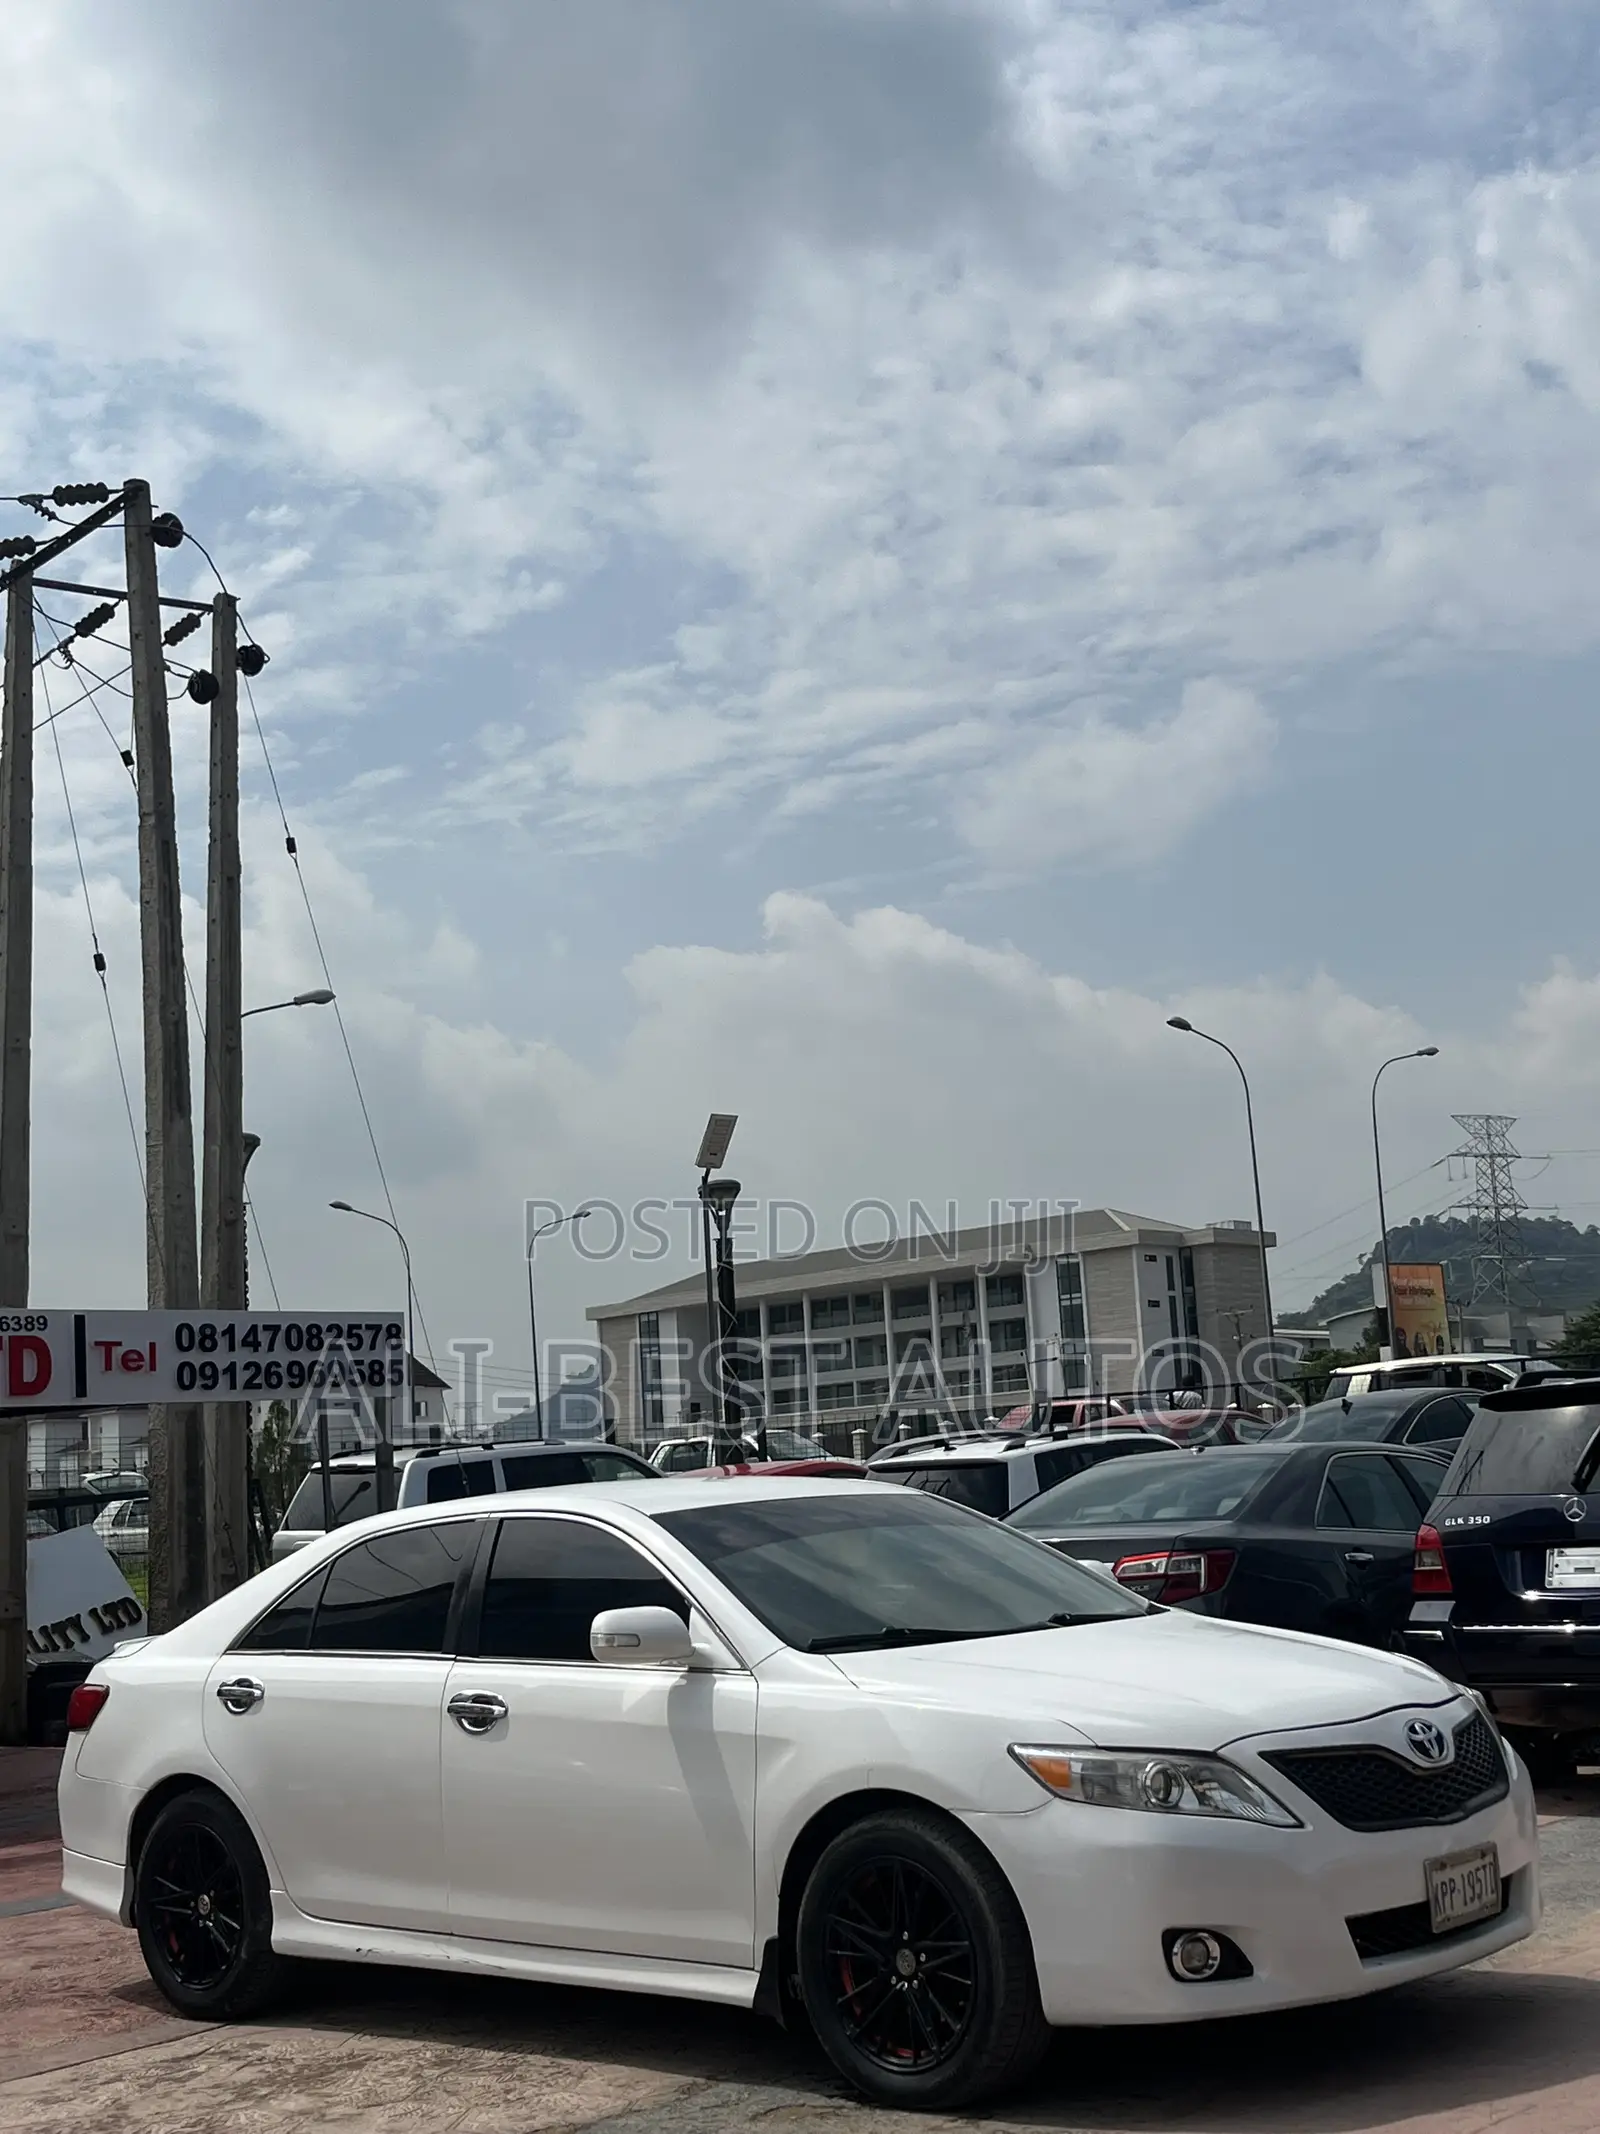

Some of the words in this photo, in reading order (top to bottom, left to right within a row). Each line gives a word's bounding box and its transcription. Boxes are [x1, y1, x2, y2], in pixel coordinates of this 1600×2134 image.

[175, 1322, 402, 1352] 08147082578
[0, 1335, 52, 1396] D
[94, 1341, 156, 1372] Tel
[1444, 1516, 1464, 1526] GLK
[1468, 1516, 1491, 1525] 350
[26, 1613, 91, 1653] LITY
[88, 1597, 142, 1635] LTD
